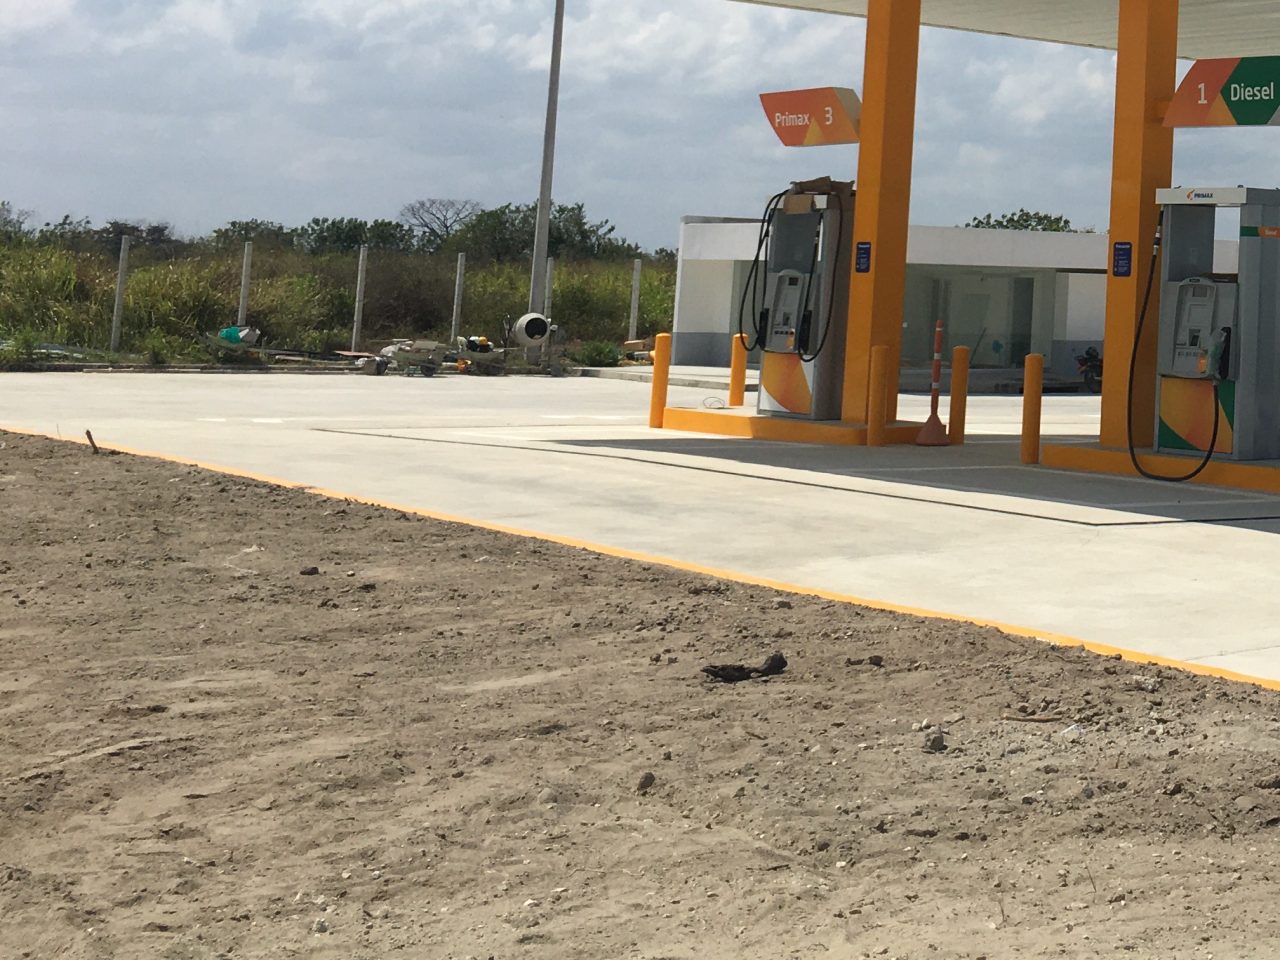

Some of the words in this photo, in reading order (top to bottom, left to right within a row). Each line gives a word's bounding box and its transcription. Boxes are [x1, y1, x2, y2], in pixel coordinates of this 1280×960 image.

[1197, 83, 1208, 105] 1
[1230, 81, 1275, 101] Diesel
[775, 111, 810, 127] Primax
[824, 106, 833, 125] 3
